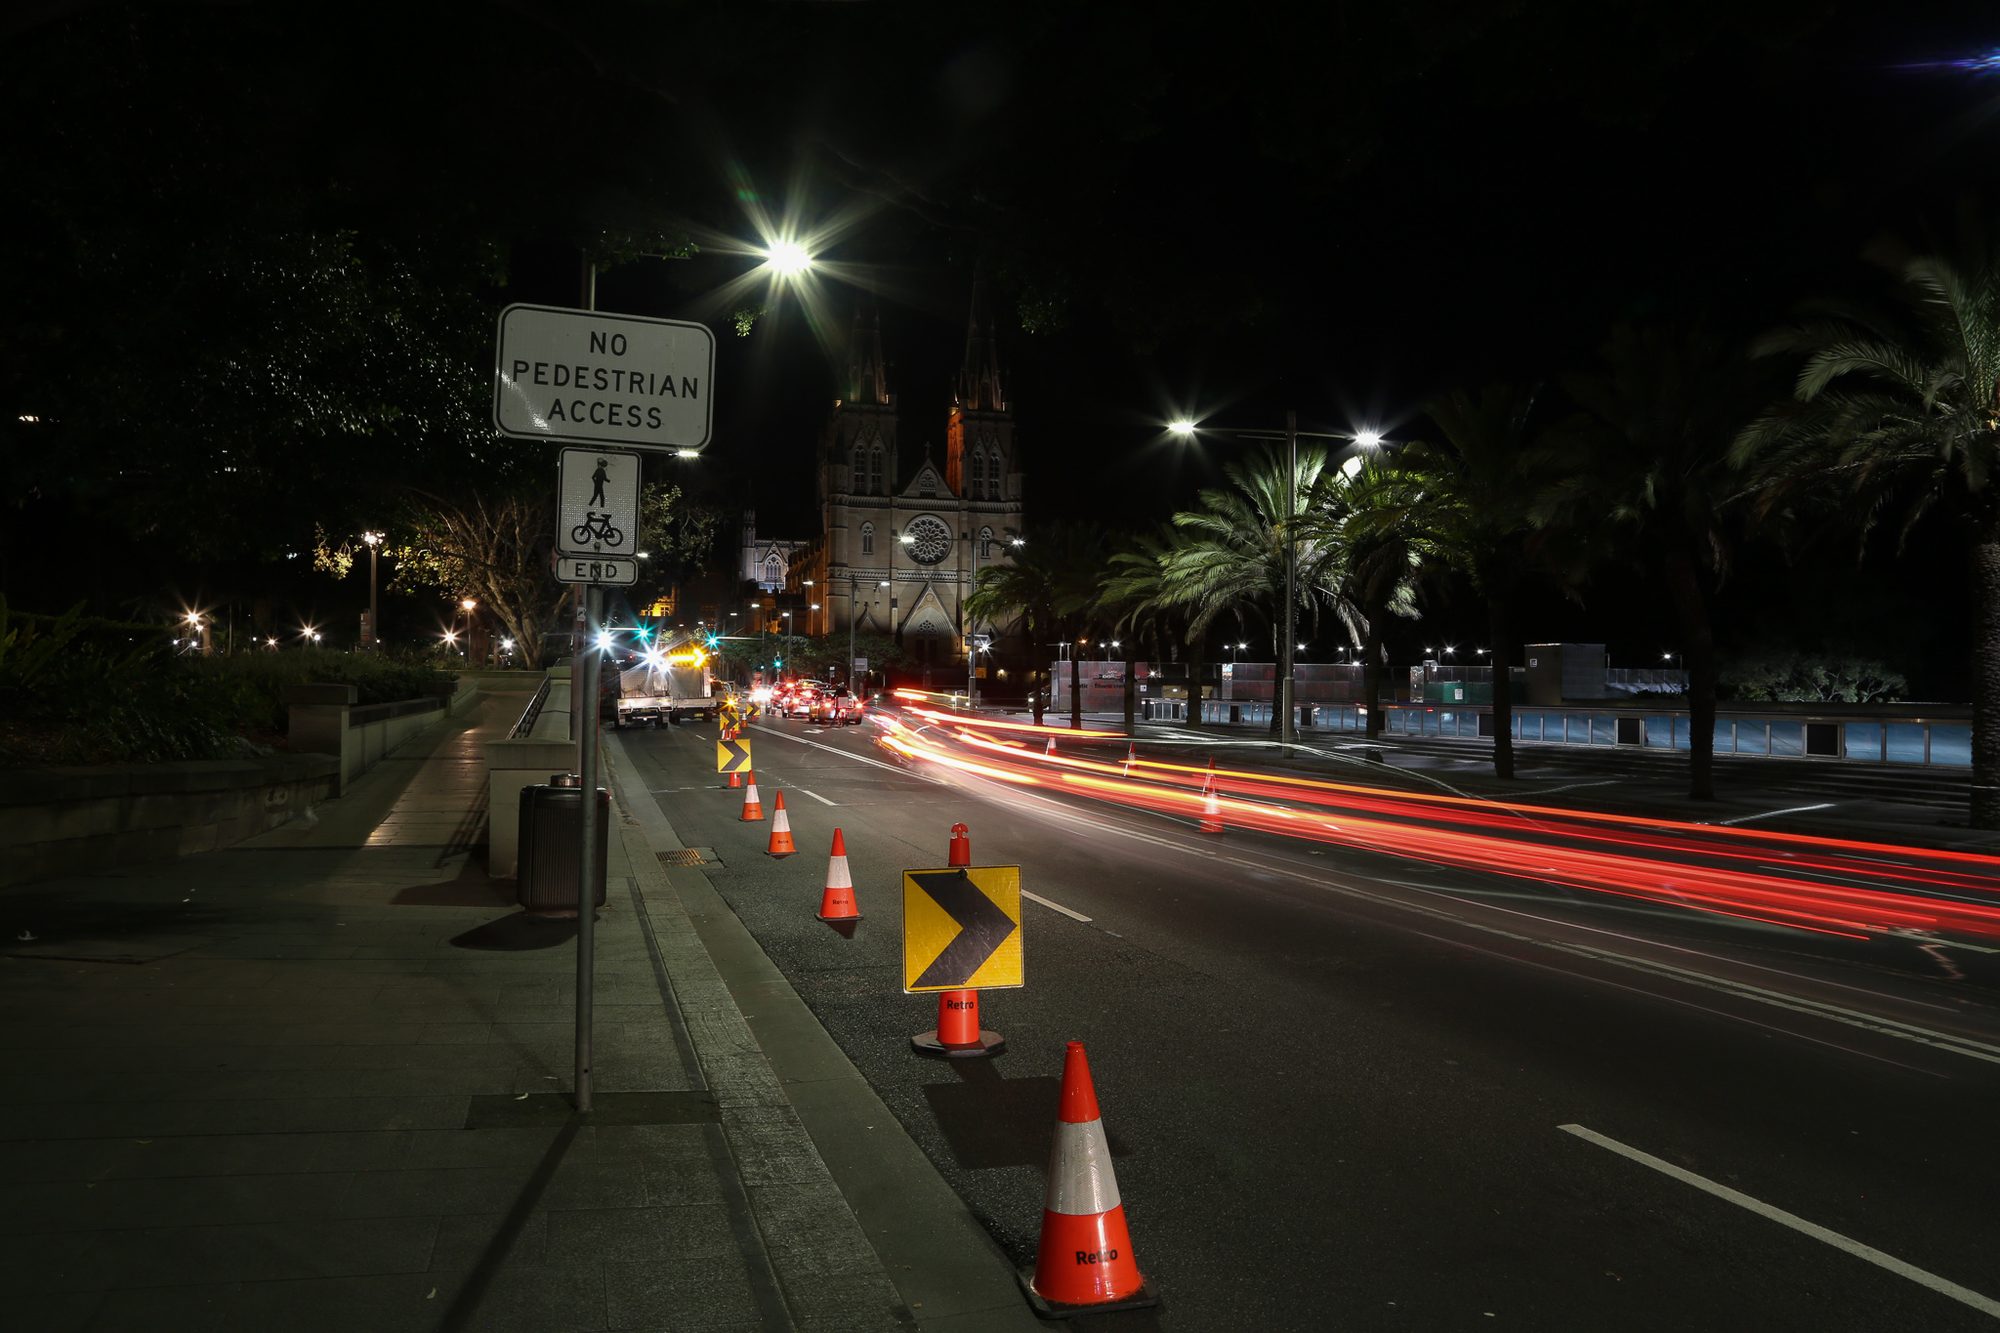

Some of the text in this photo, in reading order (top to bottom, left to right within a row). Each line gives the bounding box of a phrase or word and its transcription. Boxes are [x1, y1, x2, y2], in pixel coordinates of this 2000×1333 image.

[589, 331, 628, 356] NO
[512, 360, 698, 400] PEDESTRIAN
[547, 398, 662, 430] ACCESS
[574, 562, 618, 579] END
[946, 999, 974, 1010] Retro
[1075, 1249, 1118, 1265] Retro
